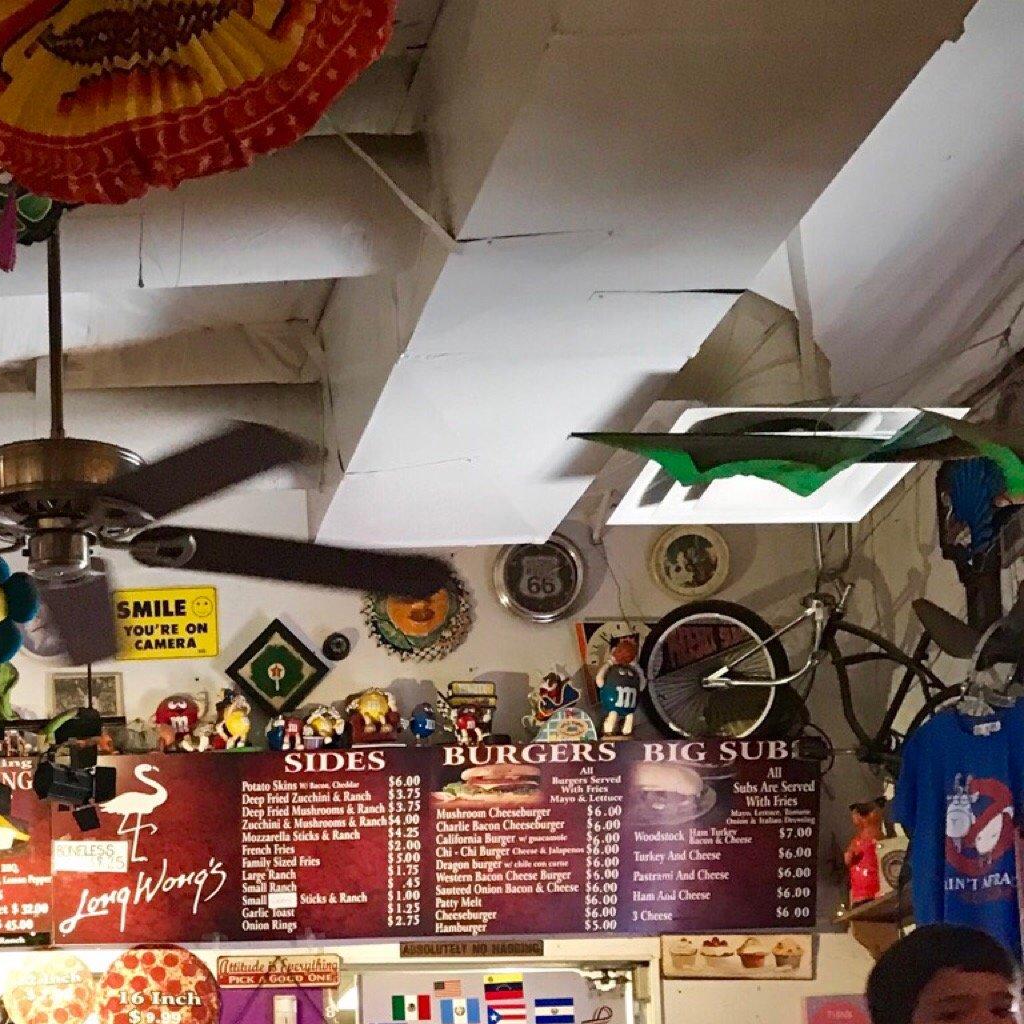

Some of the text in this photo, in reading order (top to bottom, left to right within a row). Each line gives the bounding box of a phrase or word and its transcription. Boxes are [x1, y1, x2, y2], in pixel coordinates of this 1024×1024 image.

[117, 600, 186, 619] SMILE
[124, 623, 208, 636] YOU'RE ON
[135, 637, 197, 650] CAMERA
[443, 743, 616, 765] BURGERS
[644, 742, 707, 762] BIG
[284, 751, 385, 772] SIDES
[767, 767, 782, 778] All
[242, 781, 270, 791] Potato
[273, 780, 297, 790] Skins
[388, 776, 420, 787] $6.00
[733, 780, 815, 793] Subs Are Served
[242, 788, 420, 807] Deep Fried Zucchini & Ranch $3.75
[746, 796, 797, 807] With Fries
[436, 808, 485, 819] Mushroom
[489, 808, 551, 820] Cheeseburger
[436, 822, 469, 833] Charlie
[472, 821, 500, 831] Bacon
[503, 820, 564, 833] Cheeseburger
[242, 828, 419, 842] Mozzarella Sticks & Ranch $4.25
[436, 835, 482, 846] California
[485, 834, 516, 847] Burger
[634, 831, 684, 842] Woodstock
[242, 840, 420, 855] French Fries $2.00
[242, 858, 271, 869] Family
[273, 856, 296, 867] Sized
[300, 856, 320, 866] Fries
[633, 851, 665, 864] Turkey
[668, 849, 686, 860] And
[689, 849, 721, 860] Cheese
[436, 873, 472, 883] Western
[475, 872, 503, 881] Bacon
[505, 871, 538, 881] Cheese
[541, 870, 571, 883] Burger
[633, 871, 673, 882] Pastrami
[676, 870, 695, 880] And
[697, 869, 729, 880] Cheese
[436, 885, 472, 895] Sauteed
[475, 884, 502, 894] Onion
[505, 884, 533, 893] Bacon
[535, 884, 544, 892] &
[547, 883, 579, 892] Cheese
[633, 891, 655, 901] Ham
[658, 890, 676, 901] And
[679, 889, 711, 900] Cheese
[58, 857, 227, 937] Long Wong's
[242, 908, 268, 918] Garlic
[435, 910, 496, 922] Cheeseburger
[641, 910, 673, 921] Cheese
[242, 921, 269, 931] Onion
[272, 921, 297, 933] Rings
[435, 923, 487, 935] Hamburger
[309, 974, 332, 982] ONE
[120, 990, 201, 1006] 16 Inch
